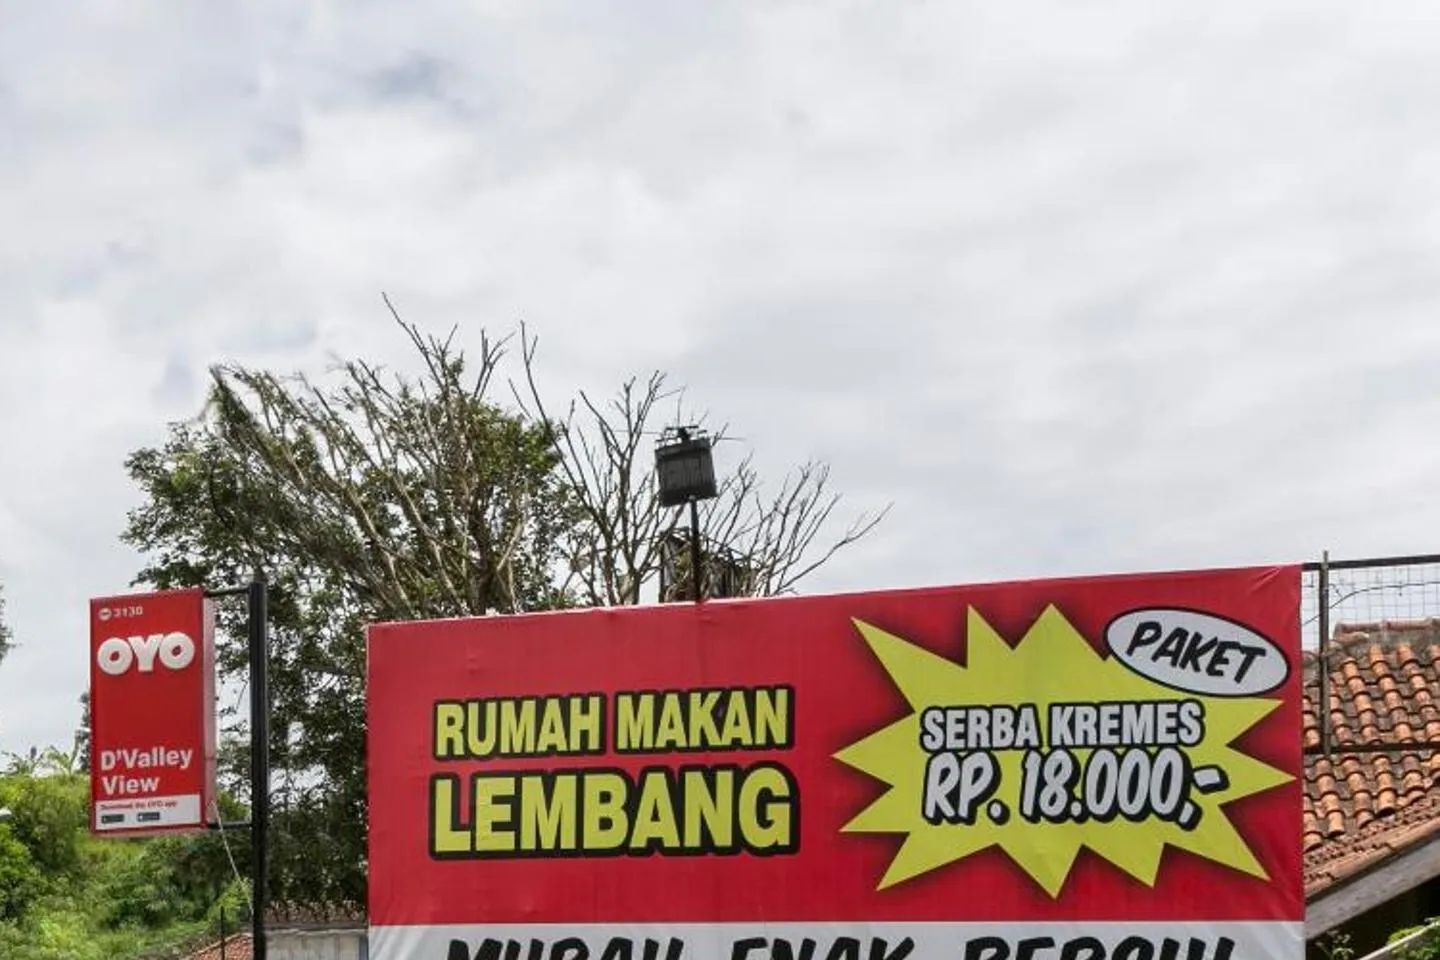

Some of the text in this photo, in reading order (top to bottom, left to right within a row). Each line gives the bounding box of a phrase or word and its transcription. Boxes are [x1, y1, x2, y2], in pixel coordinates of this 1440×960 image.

[97, 631, 195, 676] OYO
[1127, 621, 1265, 685] PAKET
[435, 688, 790, 757] RUMAH MAKAN
[921, 701, 1203, 750] SERBA KREMES
[101, 746, 193, 771] D'Valley
[102, 775, 160, 795] View
[432, 767, 796, 855] LEMBANG
[924, 747, 1228, 827] RP. 18.000,-
